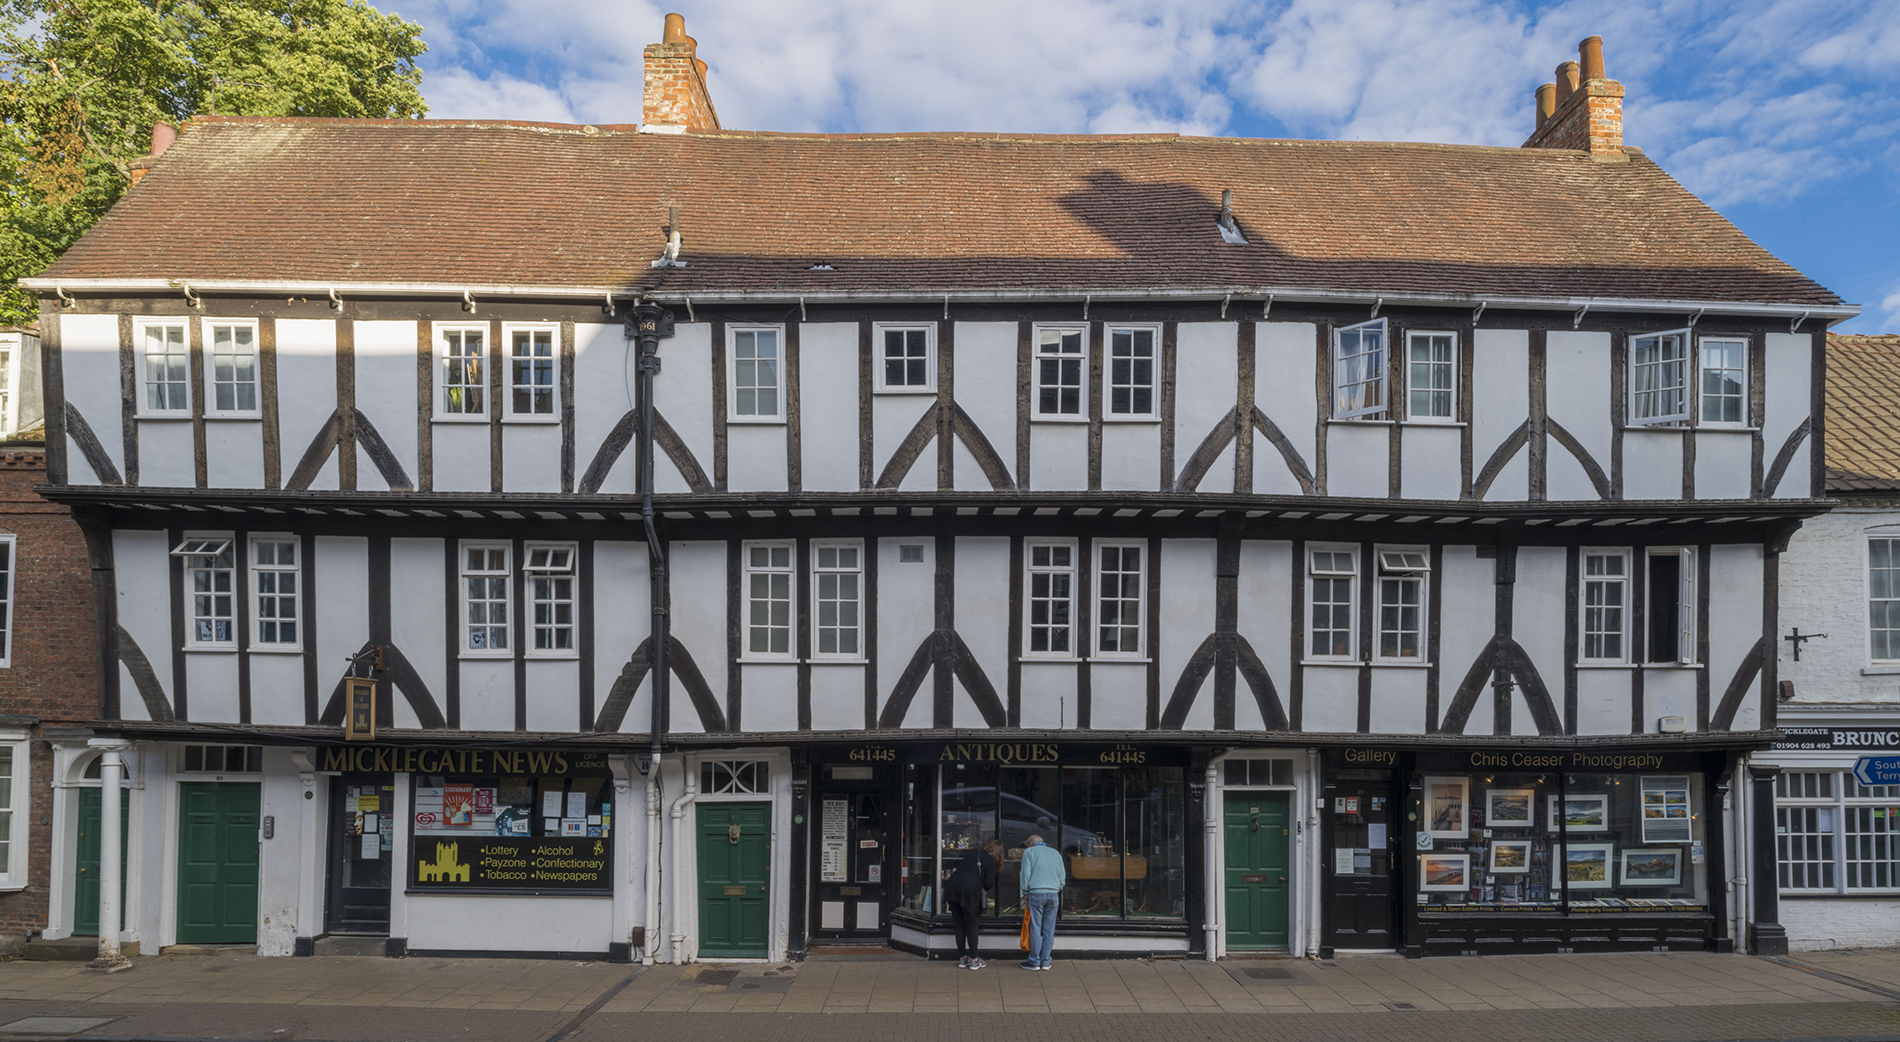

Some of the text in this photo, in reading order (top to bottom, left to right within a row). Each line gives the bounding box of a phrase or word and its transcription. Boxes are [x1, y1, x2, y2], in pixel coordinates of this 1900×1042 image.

[1833, 732, 1900, 746] BRUNC
[849, 749, 896, 762] 641445
[939, 744, 1059, 765] ANTIQUES
[1100, 751, 1146, 763] 641445
[1344, 748, 1397, 765] Gallery
[1470, 752, 1663, 769] Chris Ceaser Photography
[323, 747, 569, 775] MICKLEGATE NEWS
[517, 823, 526, 831] £5
[485, 845, 519, 857] Lottery
[537, 845, 574, 856] Alcohol
[485, 857, 527, 869] Payzone
[536, 858, 604, 870] Confectionary
[486, 869, 527, 880] Tobacco
[536, 870, 598, 882] Newspapers
